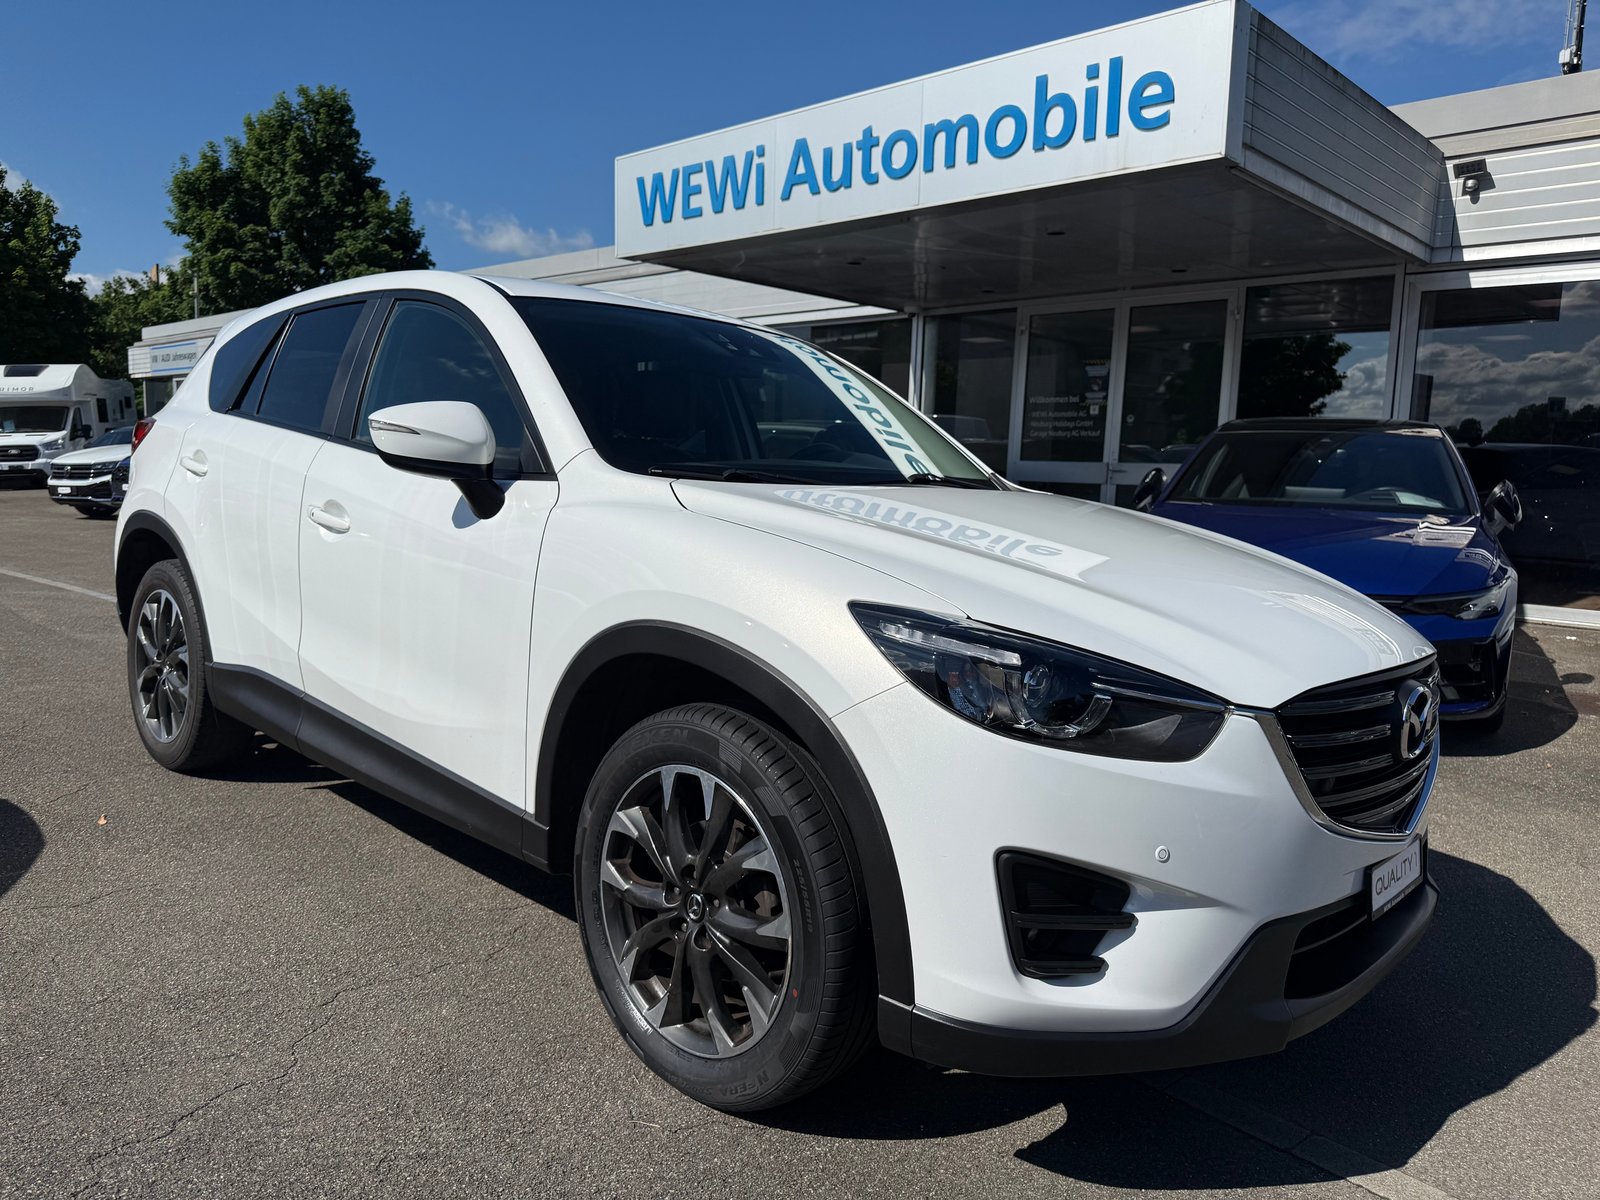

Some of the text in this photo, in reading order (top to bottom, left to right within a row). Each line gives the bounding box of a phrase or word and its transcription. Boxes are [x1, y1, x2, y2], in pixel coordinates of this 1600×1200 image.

[636, 56, 1176, 227] WEWi Automobile
[1375, 854, 1413, 896] QUALITY
